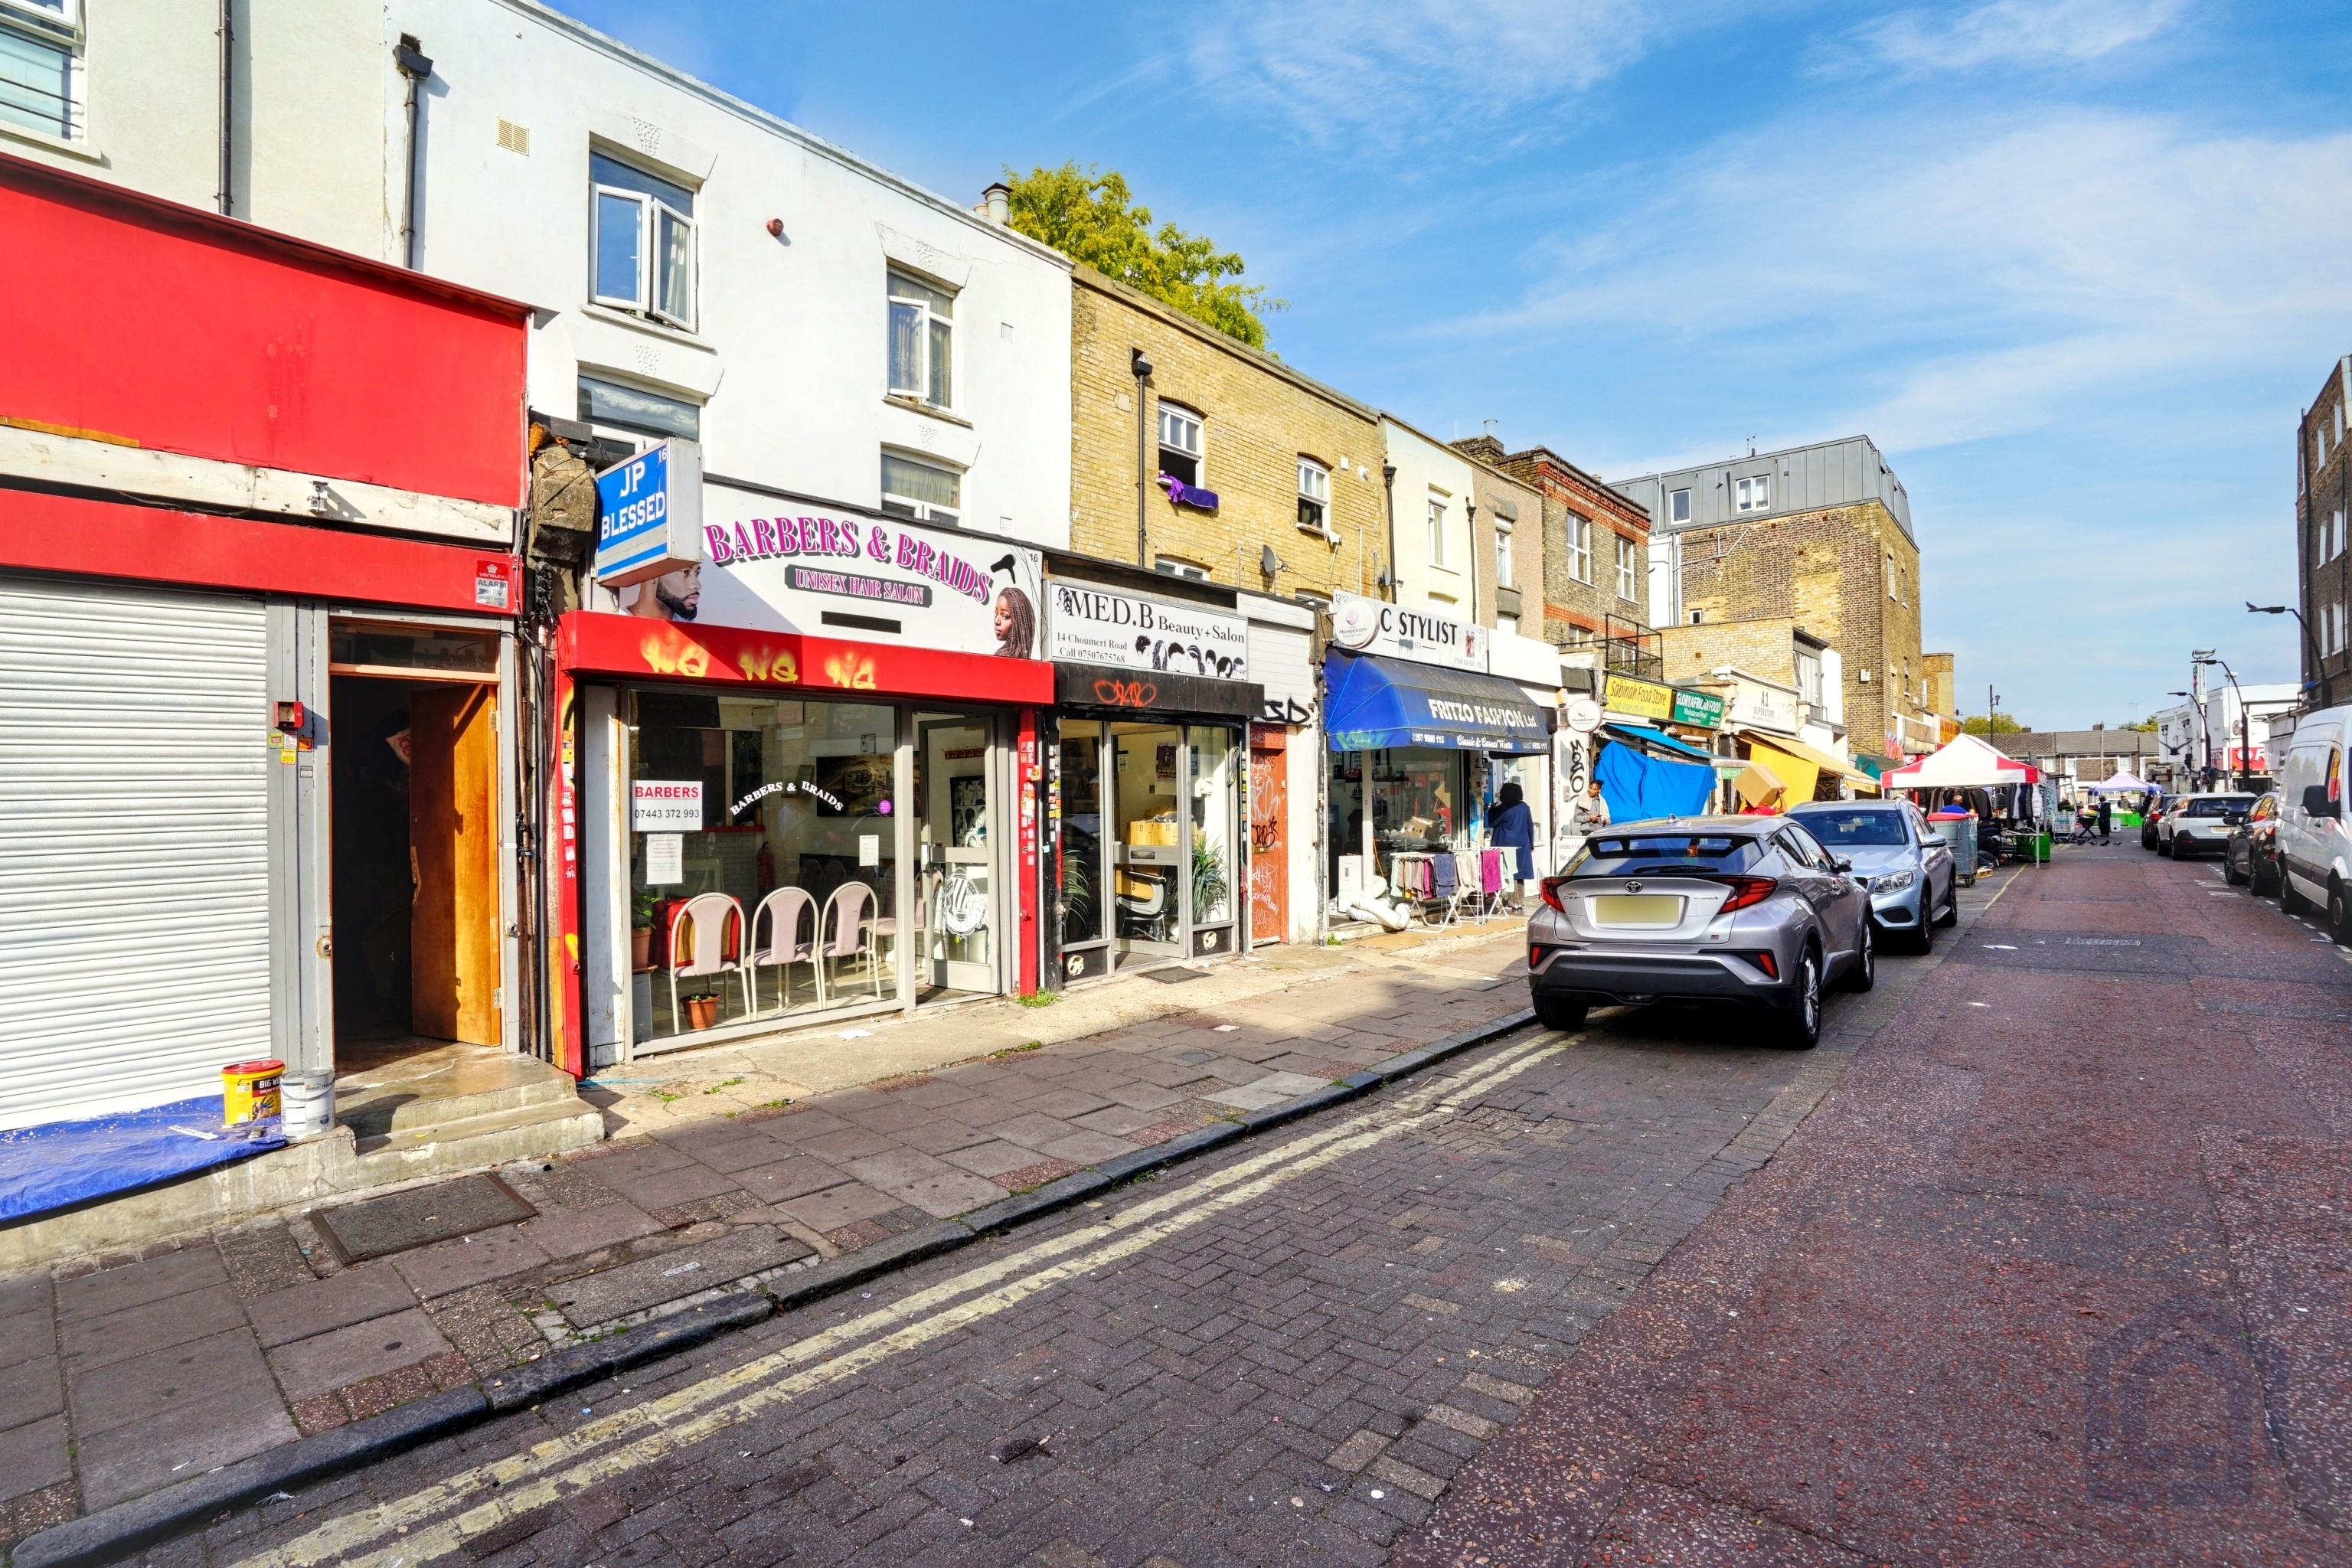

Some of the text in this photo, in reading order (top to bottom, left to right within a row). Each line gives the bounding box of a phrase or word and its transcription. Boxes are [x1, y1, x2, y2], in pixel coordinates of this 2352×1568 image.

[658, 448, 667, 462] 16
[620, 461, 645, 497] JP
[601, 491, 666, 541] BLESSED
[703, 517, 992, 604] BARBERS & BRAIDS
[478, 580, 506, 589] ALARM
[795, 568, 925, 604] UNISEX HAIR SALON
[1068, 589, 1154, 629] MED.B
[1157, 615, 1204, 640] Beauty
[1212, 625, 1245, 643] Salon
[1399, 612, 1458, 645] STYLIST
[1057, 632, 1128, 651] 14 Choumert Road
[1060, 646, 1076, 658] Call
[1610, 681, 1667, 707] Sabinah Food Store
[1676, 692, 1691, 707] GLORY
[1709, 700, 1721, 714] FOOD
[1760, 690, 1769, 707] A1
[1427, 698, 1475, 723] FRITZO
[1473, 705, 1525, 728] FASHION
[1753, 706, 1775, 719] SUPERSTORE
[1456, 734, 1475, 746] Classic
[1481, 736, 1498, 748] Casual
[634, 786, 699, 798] BARBERS
[729, 780, 844, 816] BARBERS & BRAIDS
[634, 809, 700, 819] 07443 372 993
[259, 1080, 272, 1089] BIG
